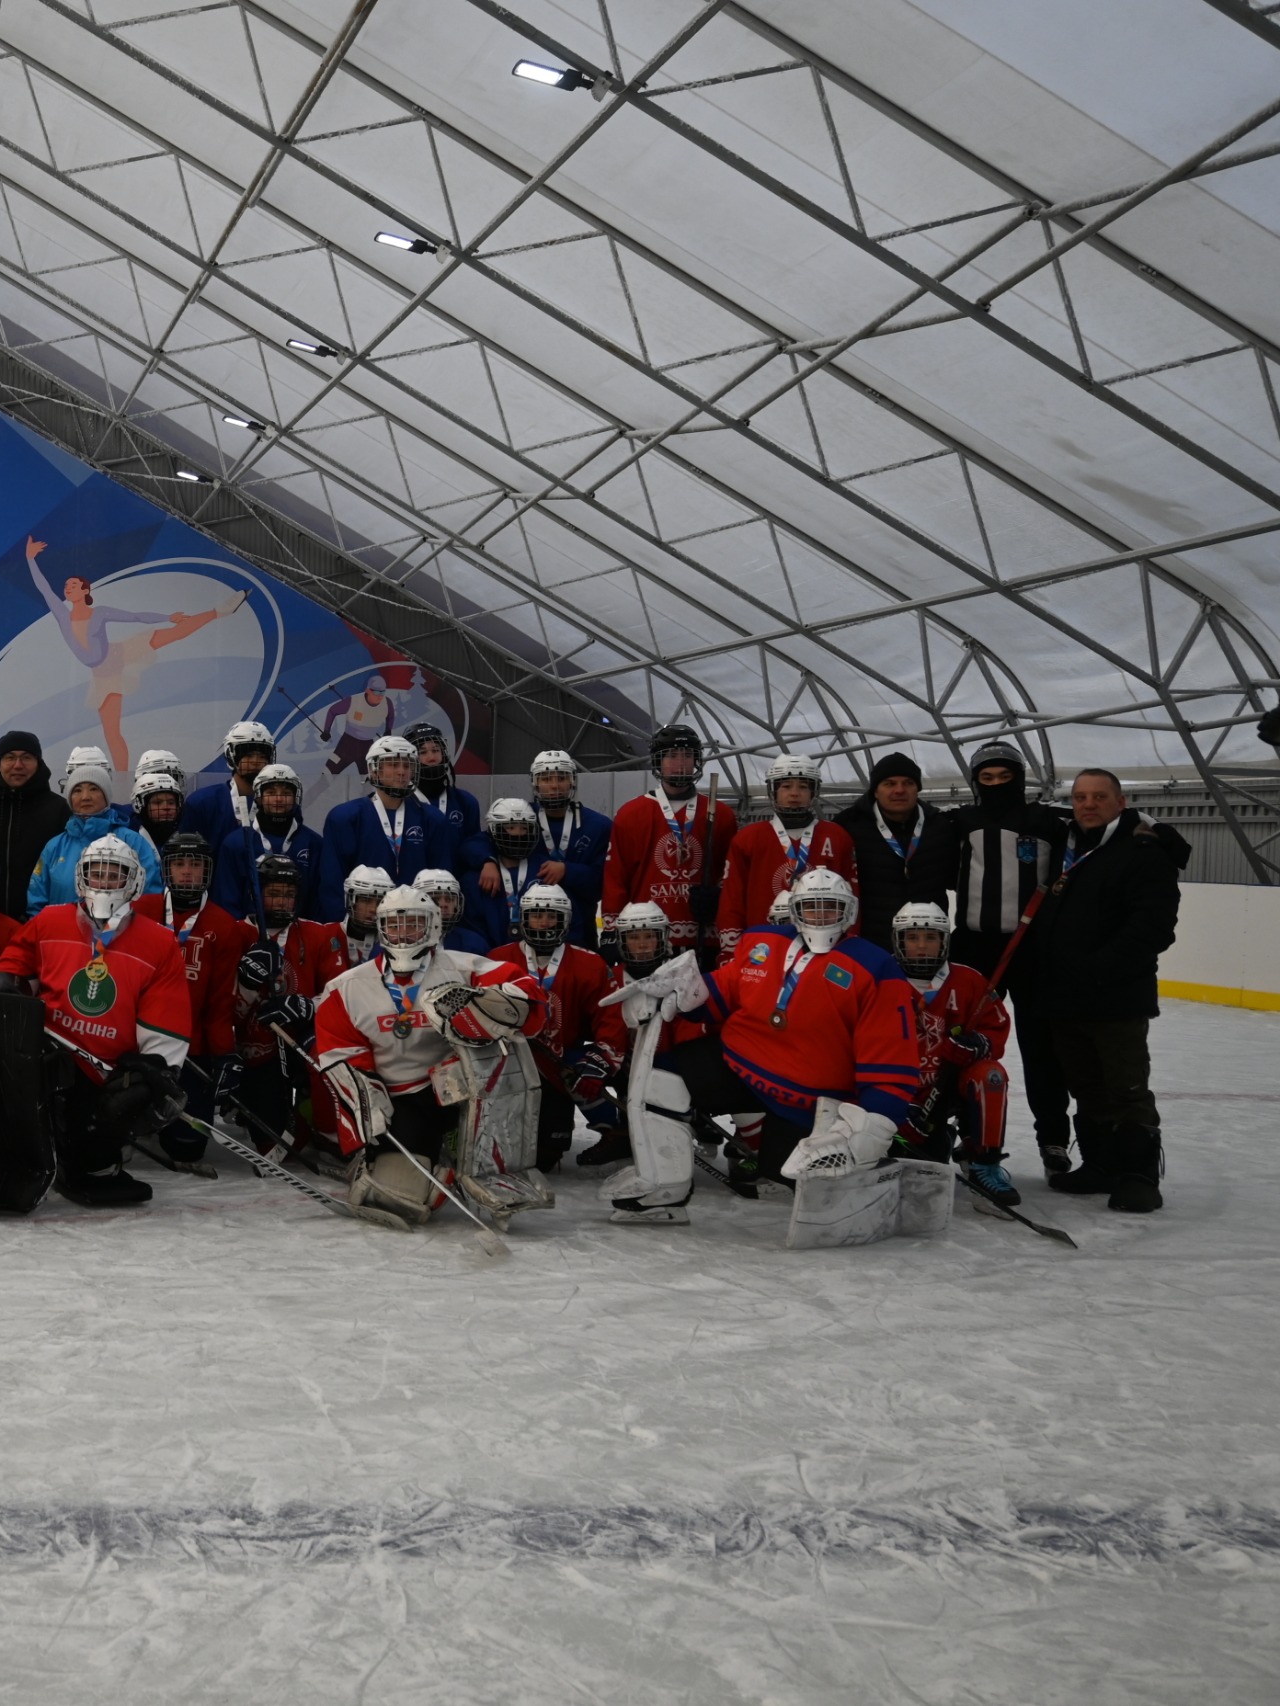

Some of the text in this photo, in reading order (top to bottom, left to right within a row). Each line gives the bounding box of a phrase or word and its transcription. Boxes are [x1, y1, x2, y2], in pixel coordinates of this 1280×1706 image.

[821, 837, 834, 857] A
[650, 884, 691, 898] SAMR
[946, 989, 959, 1011] A
[52, 1008, 117, 1040] Родина
